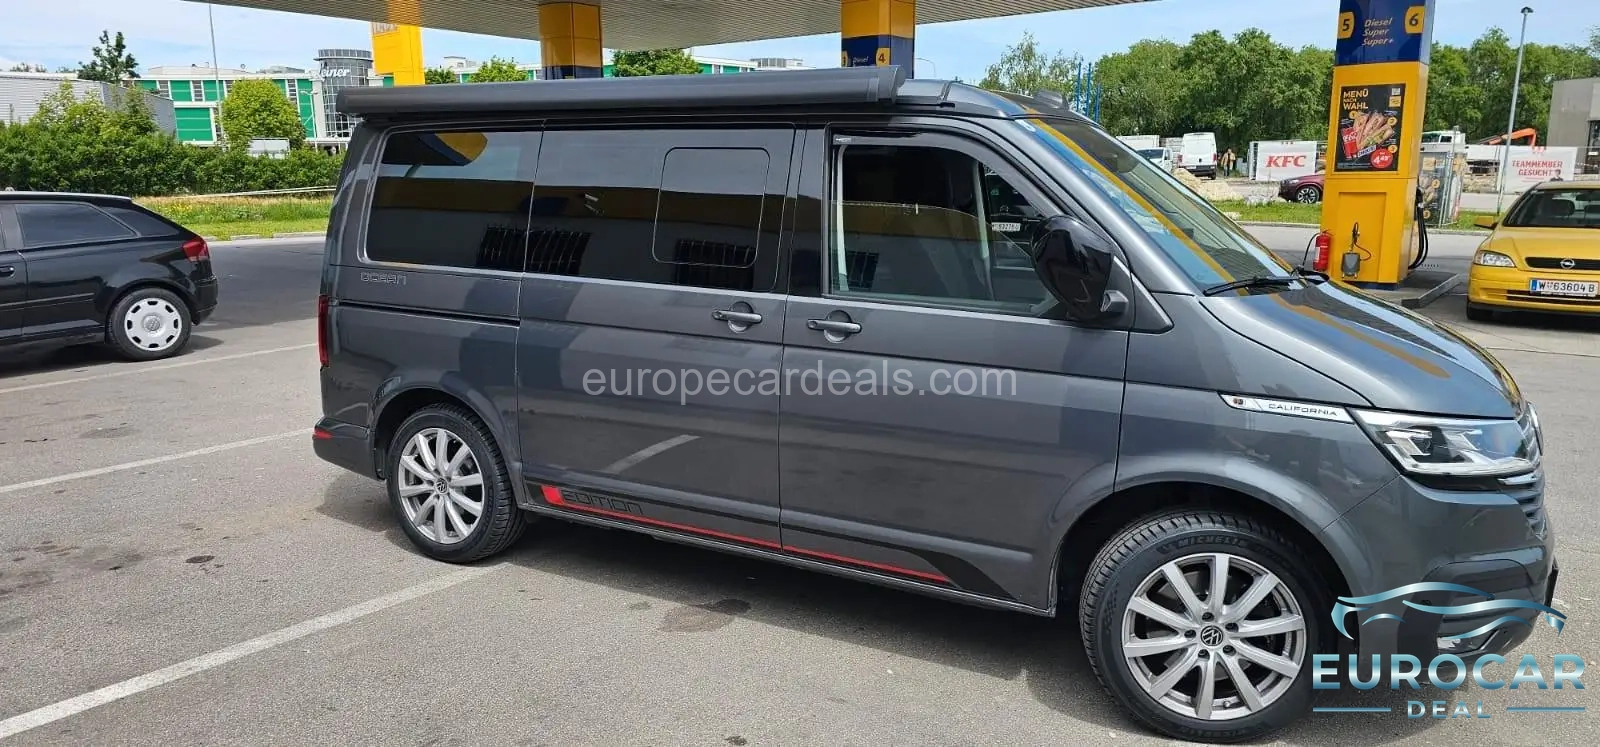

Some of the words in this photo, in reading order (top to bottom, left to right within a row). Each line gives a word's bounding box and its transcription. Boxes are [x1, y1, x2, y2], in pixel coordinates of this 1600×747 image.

[1342, 18, 1351, 31] 5
[1364, 17, 1393, 27] Diesel
[1409, 13, 1419, 26] 6
[1363, 28, 1390, 37] Super
[879, 53, 887, 63] 4
[1344, 102, 1368, 110] WAHL
[1266, 155, 1307, 167] KFC
[1512, 160, 1563, 168] TEAMMEMBER
[1539, 281, 1546, 290] W
[1268, 403, 1338, 416] CALIFORNIA
[562, 489, 643, 515] EDITION
